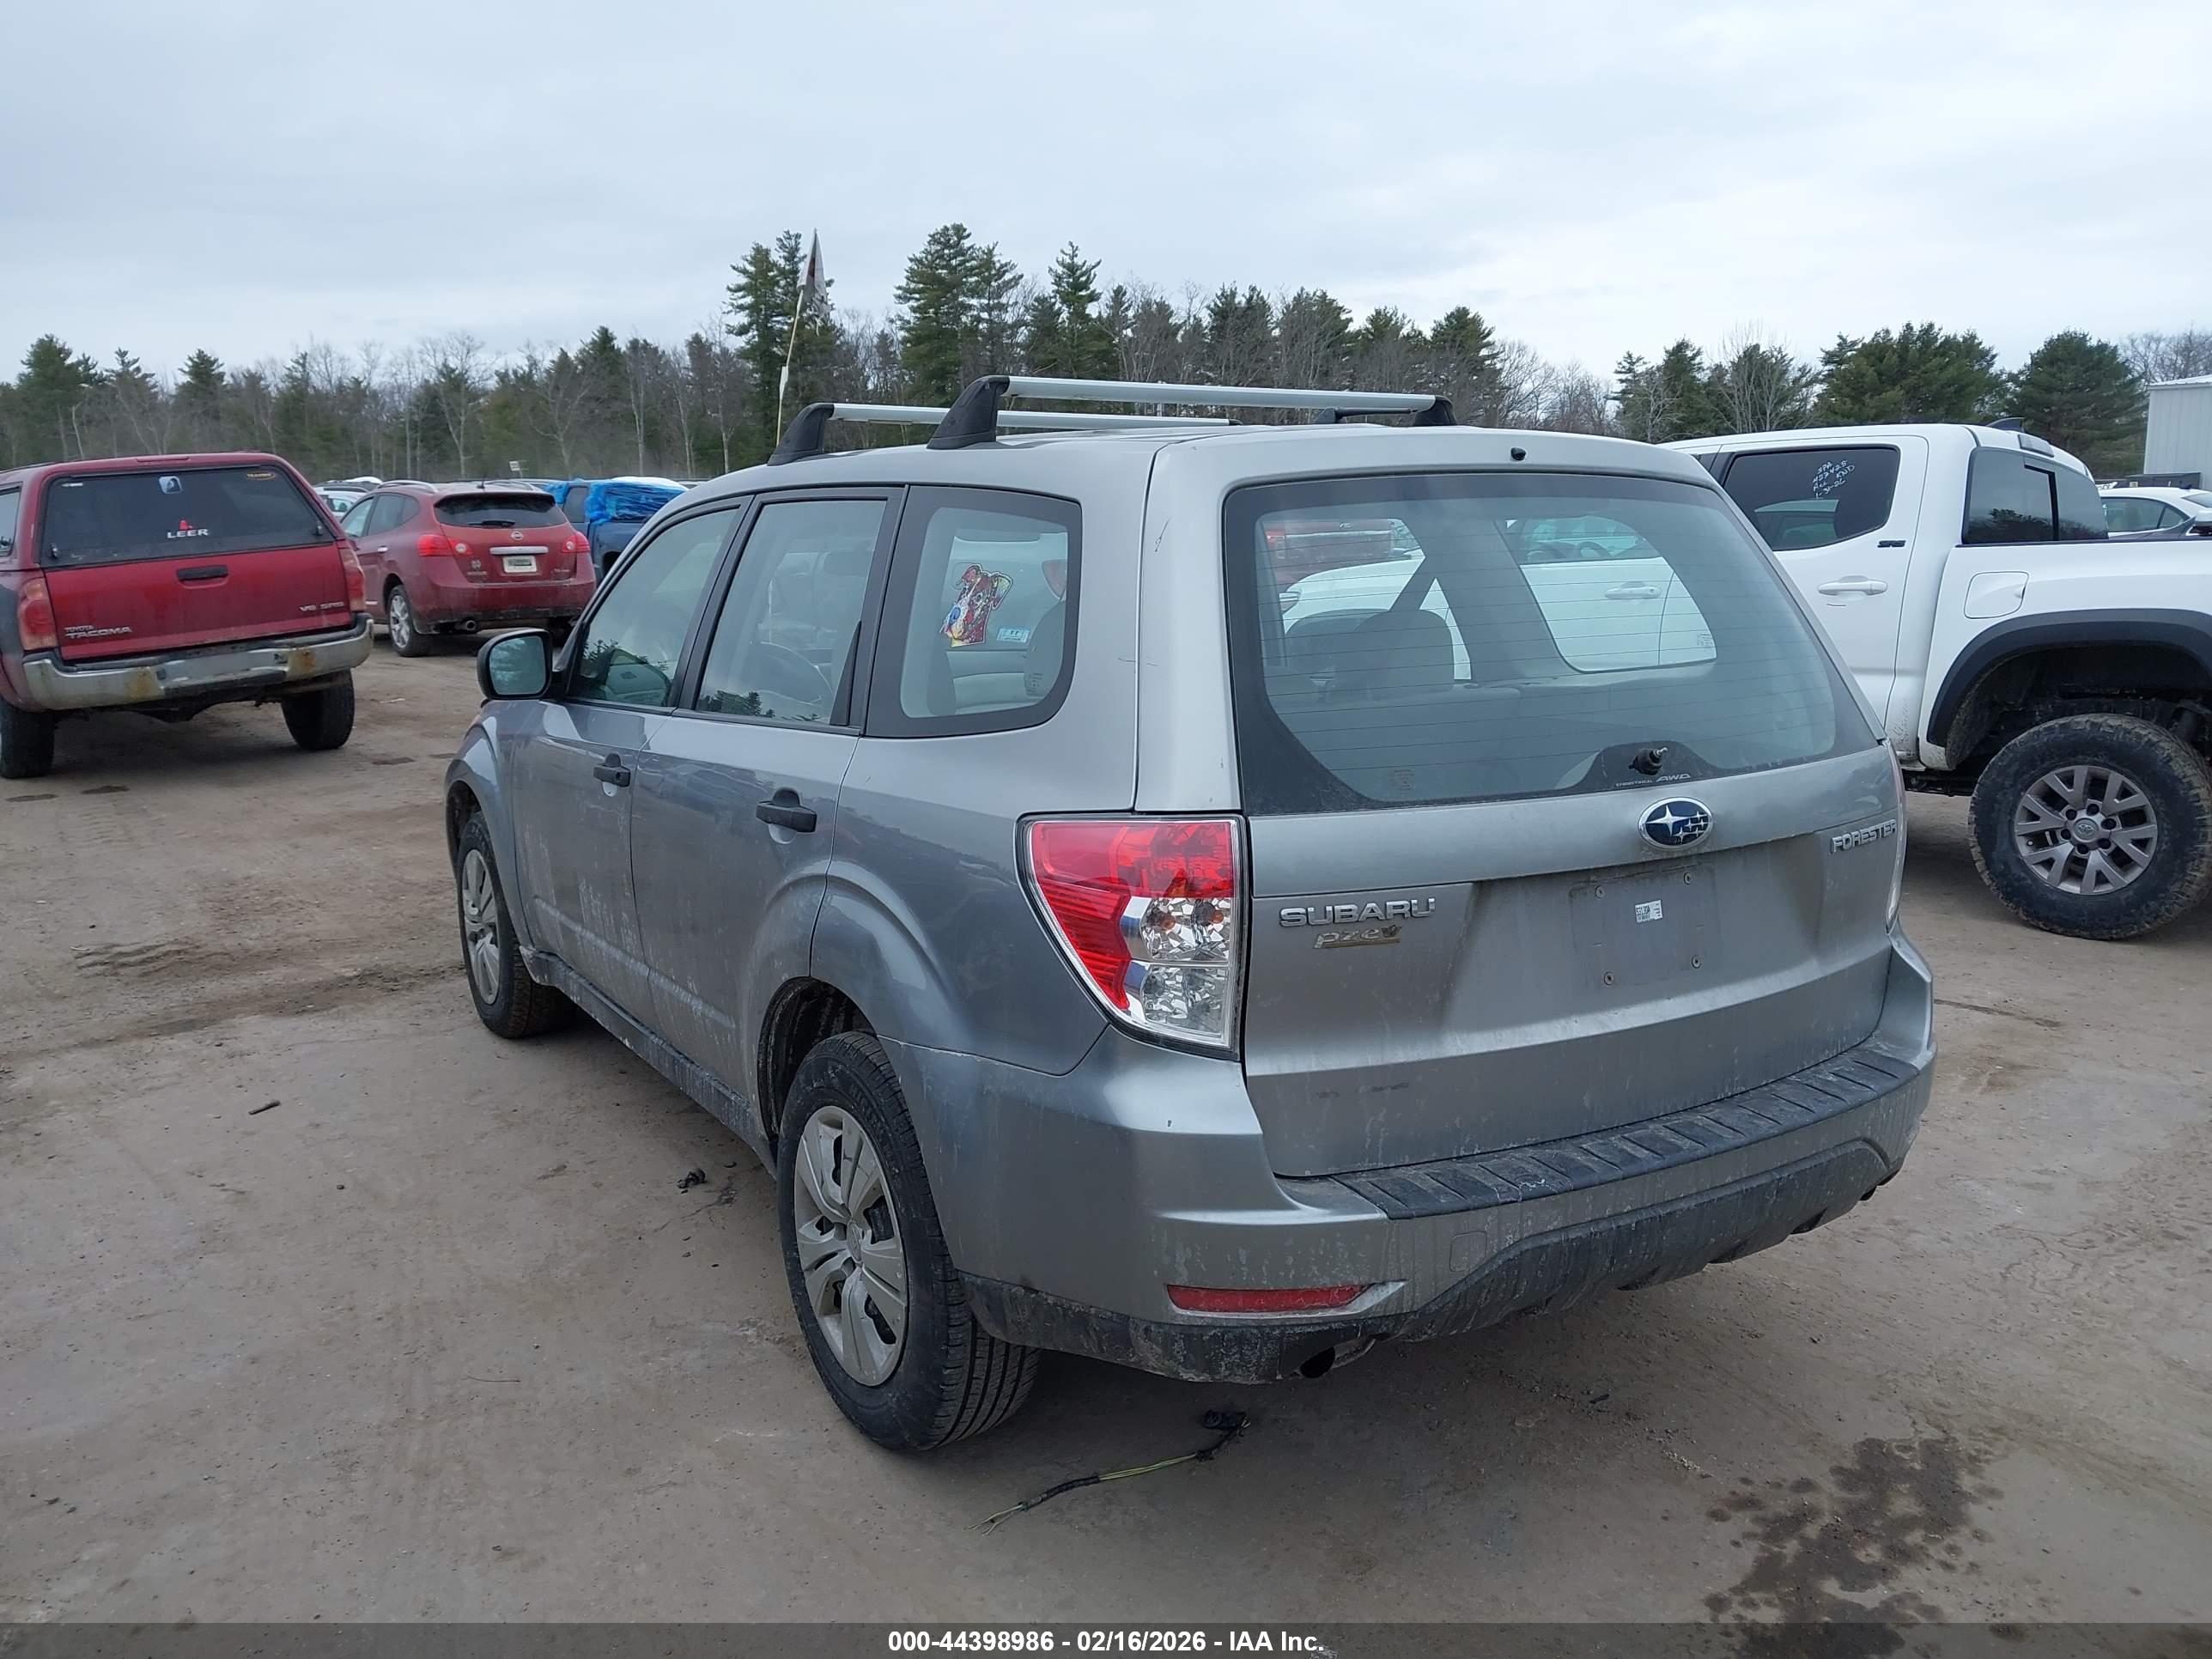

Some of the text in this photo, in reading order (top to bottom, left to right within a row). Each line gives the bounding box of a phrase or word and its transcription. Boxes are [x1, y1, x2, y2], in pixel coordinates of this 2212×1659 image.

[167, 528, 209, 539] LEER
[65, 627, 132, 639] TACOMA
[1656, 773, 1691, 782] AWD
[1830, 818, 1897, 853] FORESTER
[1279, 898, 1436, 927] SUBARU
